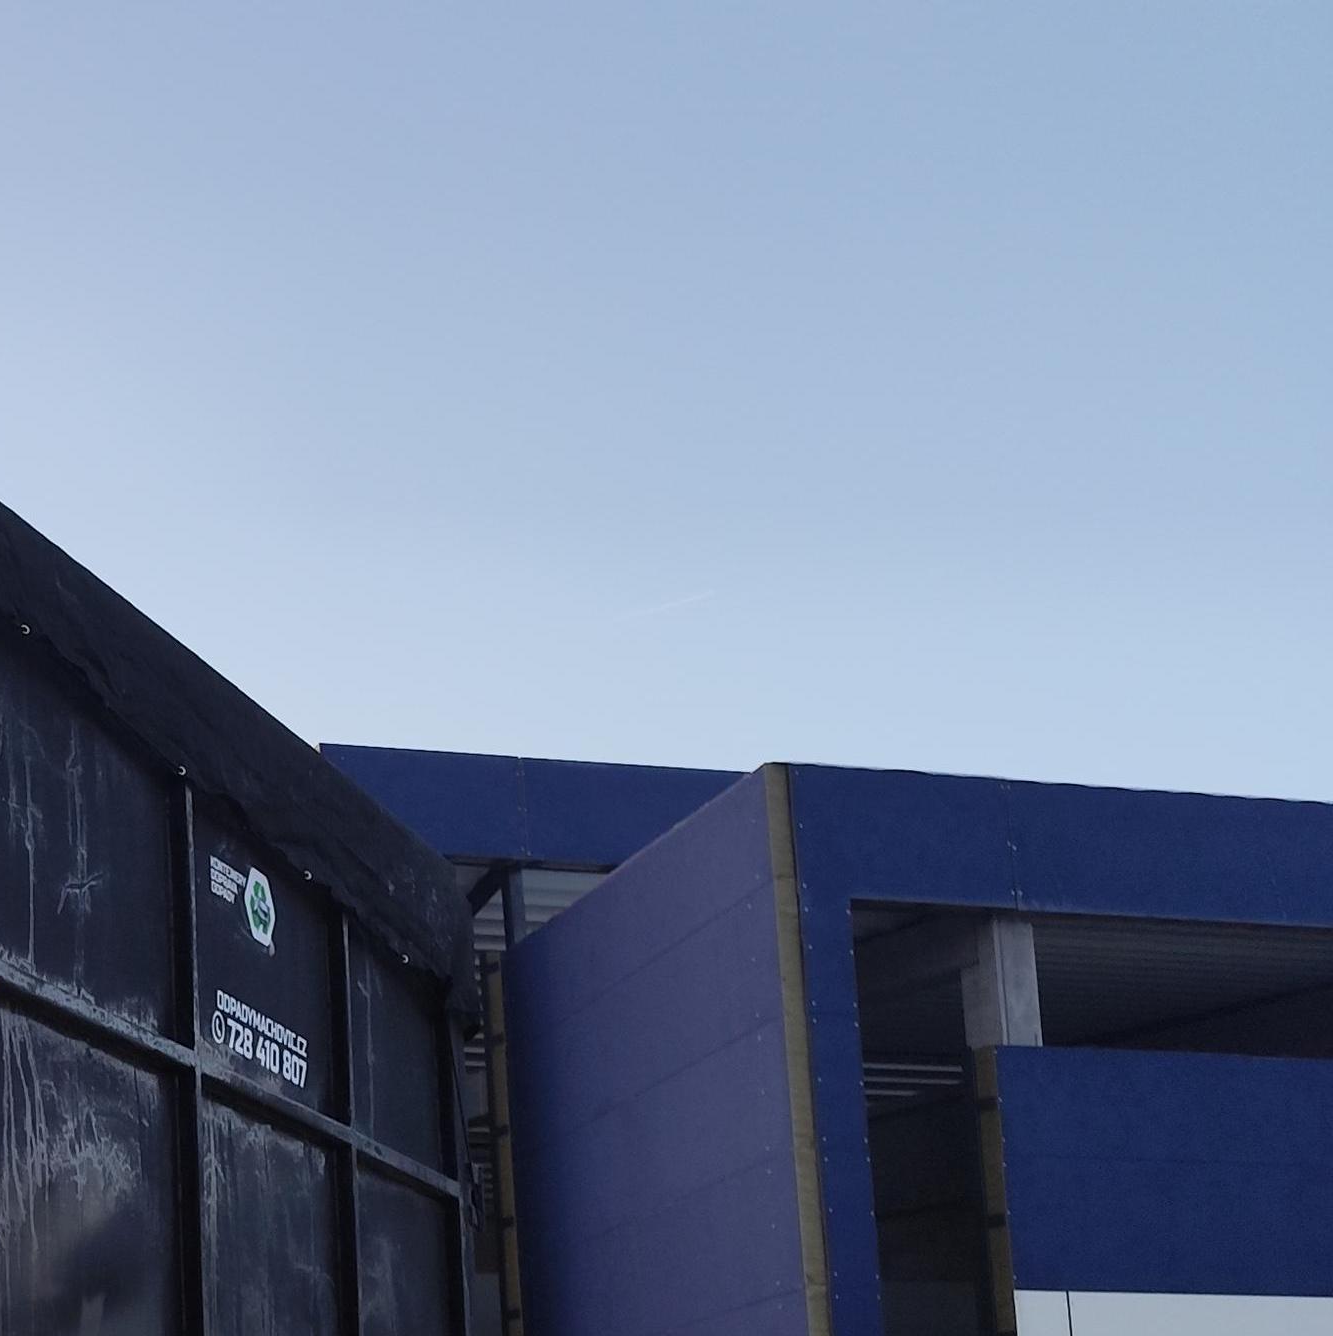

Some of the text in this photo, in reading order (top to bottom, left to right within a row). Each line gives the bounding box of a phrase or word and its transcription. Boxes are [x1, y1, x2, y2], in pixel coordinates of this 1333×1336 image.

[226, 1018, 308, 1089] 728 410 807
